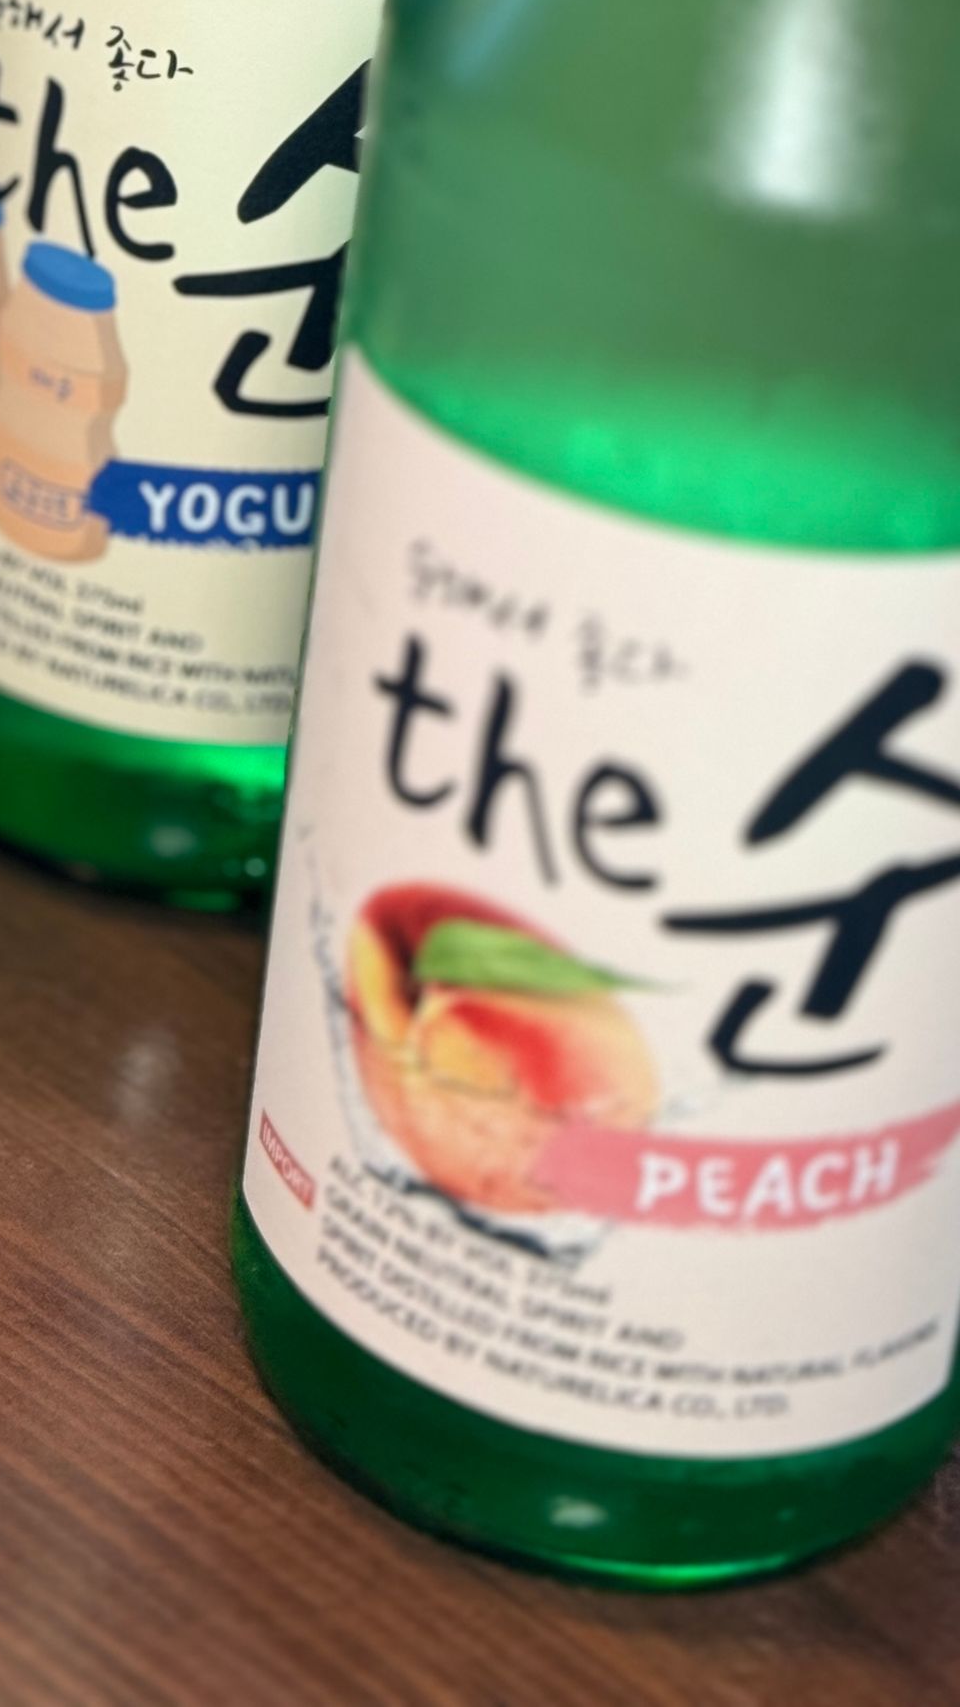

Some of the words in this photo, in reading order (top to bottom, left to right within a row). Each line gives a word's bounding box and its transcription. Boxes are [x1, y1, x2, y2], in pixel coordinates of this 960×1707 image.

[106, 26, 194, 92] 좋다
[138, 480, 316, 536] YOGU
[373, 630, 662, 890] the
[657, 652, 960, 1082] 순
[259, 1120, 314, 1206] IMPORT
[632, 1136, 899, 1218] PEACH
[615, 1321, 688, 1352] AND
